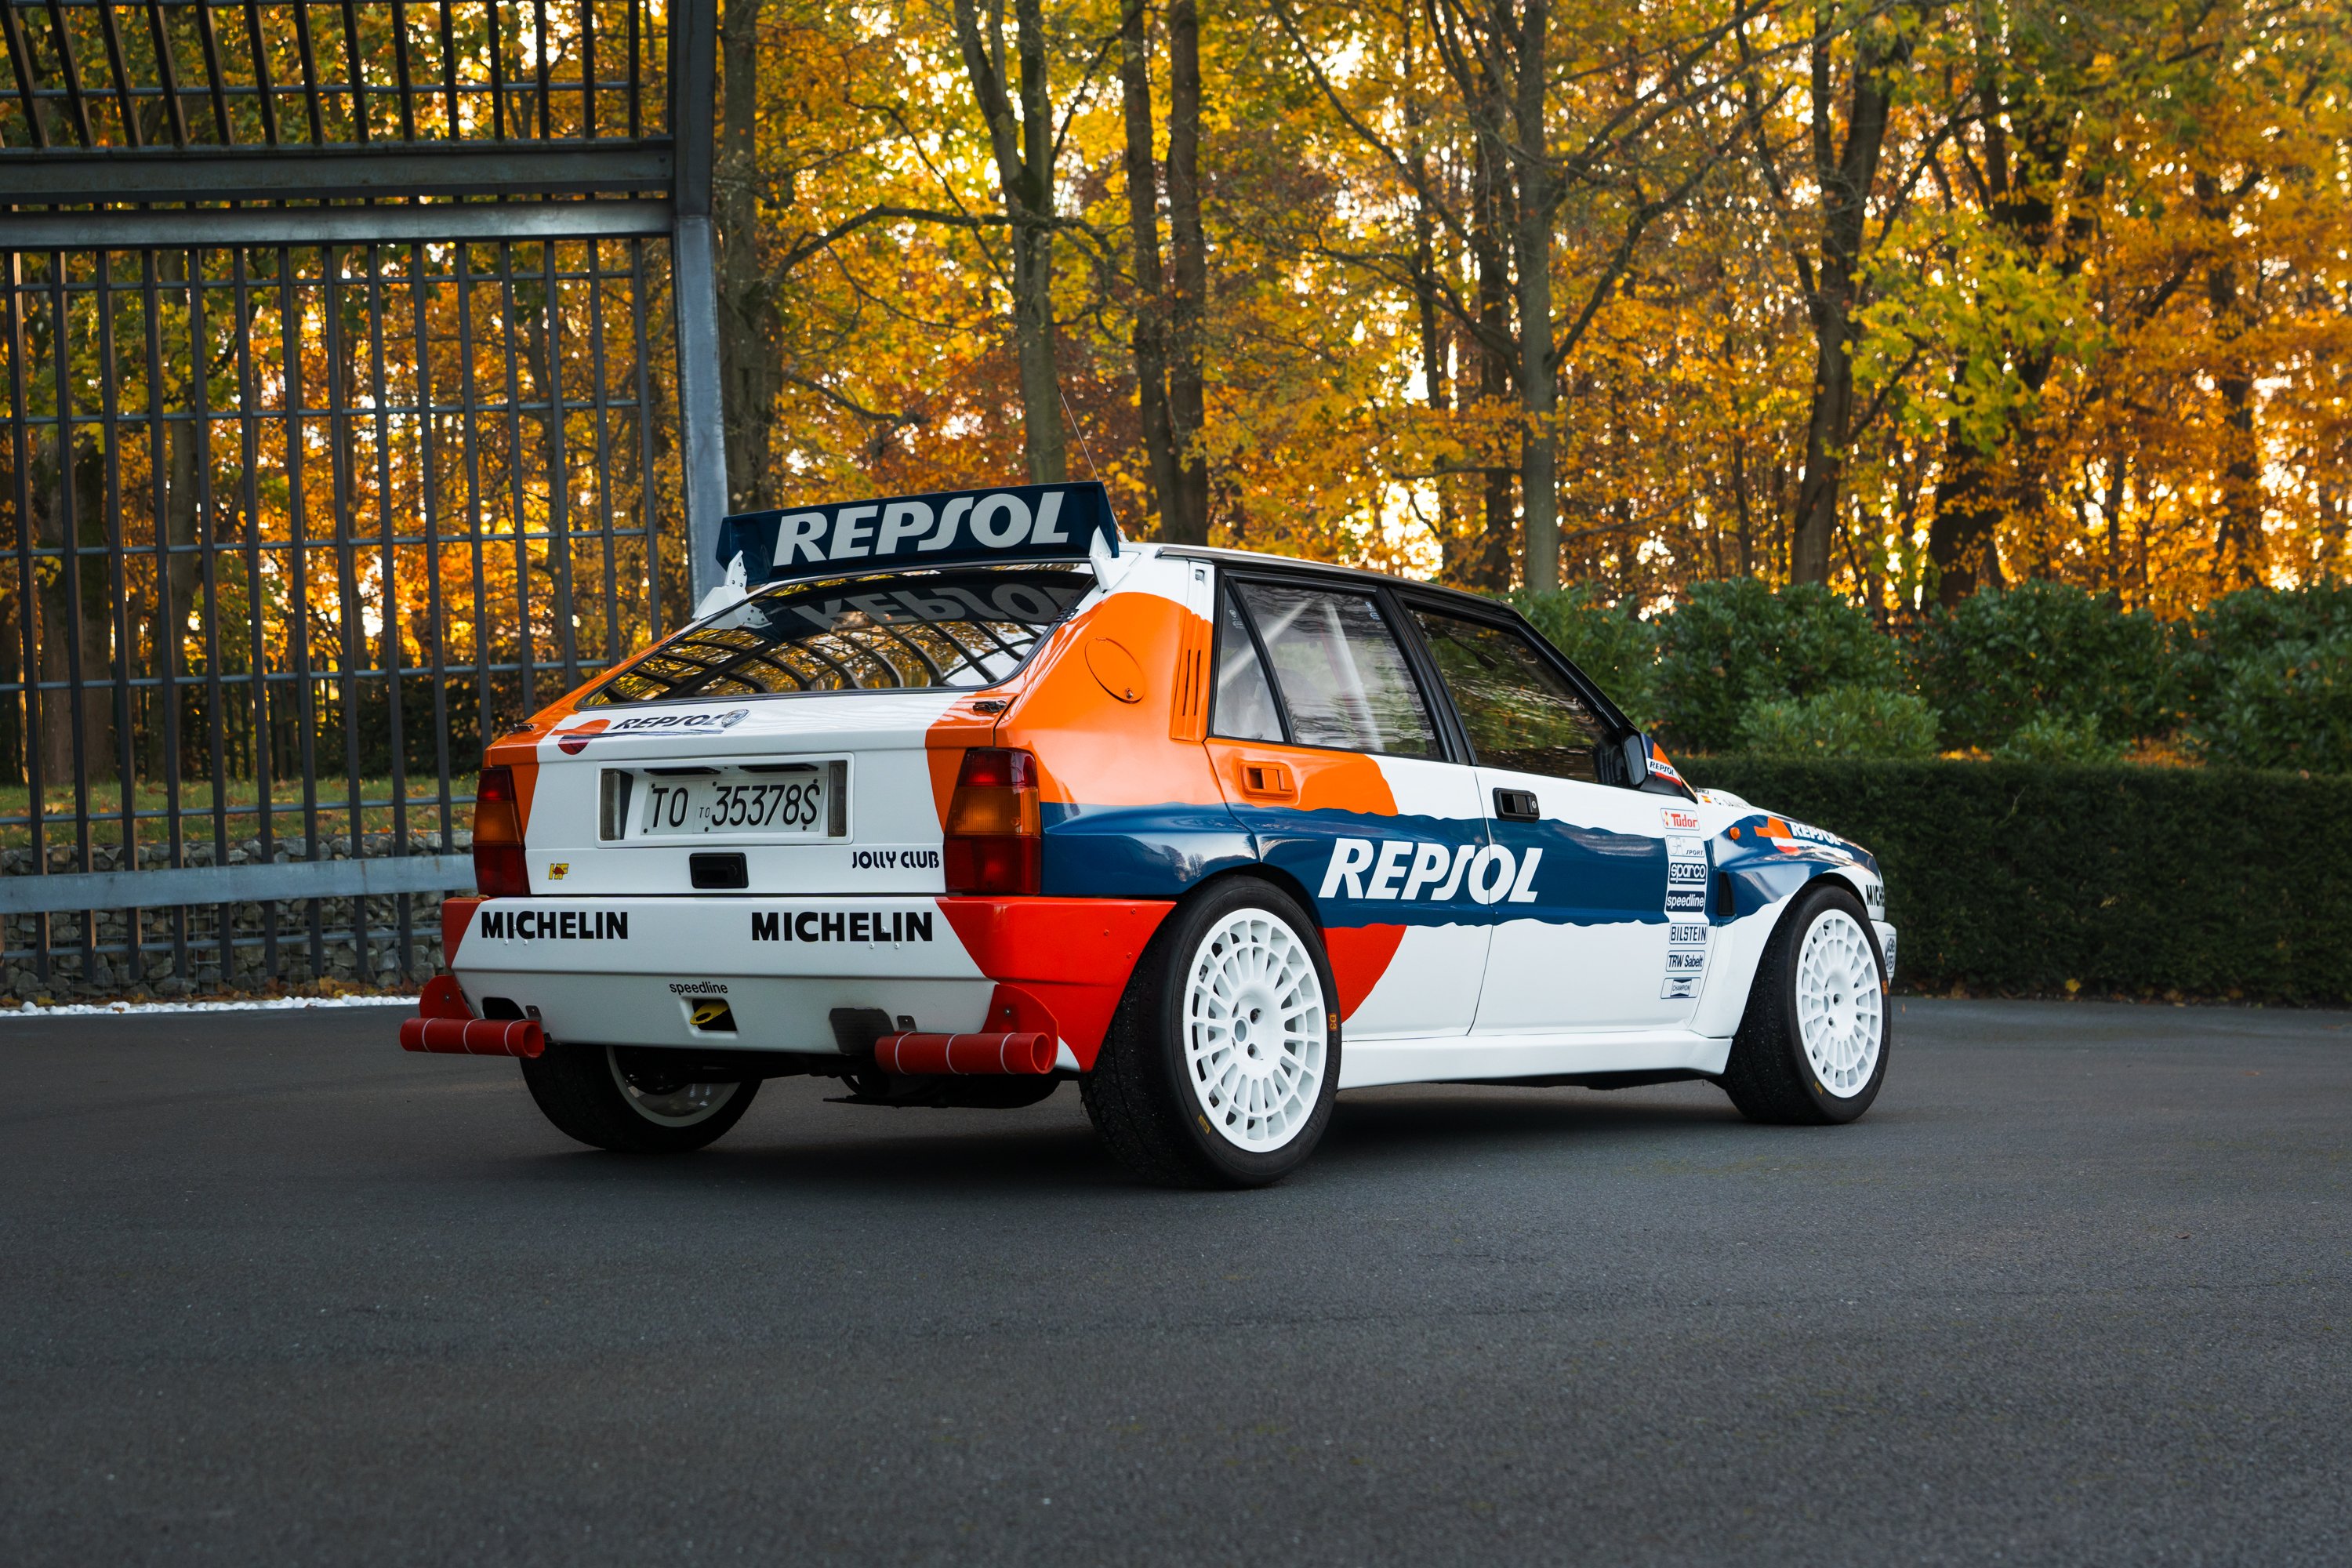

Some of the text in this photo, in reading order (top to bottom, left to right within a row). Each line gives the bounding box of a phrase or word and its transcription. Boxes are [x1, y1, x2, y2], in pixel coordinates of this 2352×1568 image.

[773, 492, 1069, 566] REPSOL
[611, 714, 726, 730] REPSOL
[1650, 760, 1675, 776] REPSOL
[652, 785, 820, 827] TO TO 35378S
[1671, 813, 1698, 828] Tudor
[1789, 821, 1841, 846] REPSOL
[851, 851, 940, 869] JOLLY CLUB
[1318, 838, 1543, 904] REPSOL
[1670, 863, 1706, 883] sparco
[1667, 892, 1704, 908] speedline
[481, 910, 629, 940] MICHELIN
[751, 911, 933, 943] MICHELIN
[1671, 926, 1707, 942] BILSTEIN
[1668, 954, 1704, 967] TRW Sabelt
[669, 981, 728, 996] speedline
